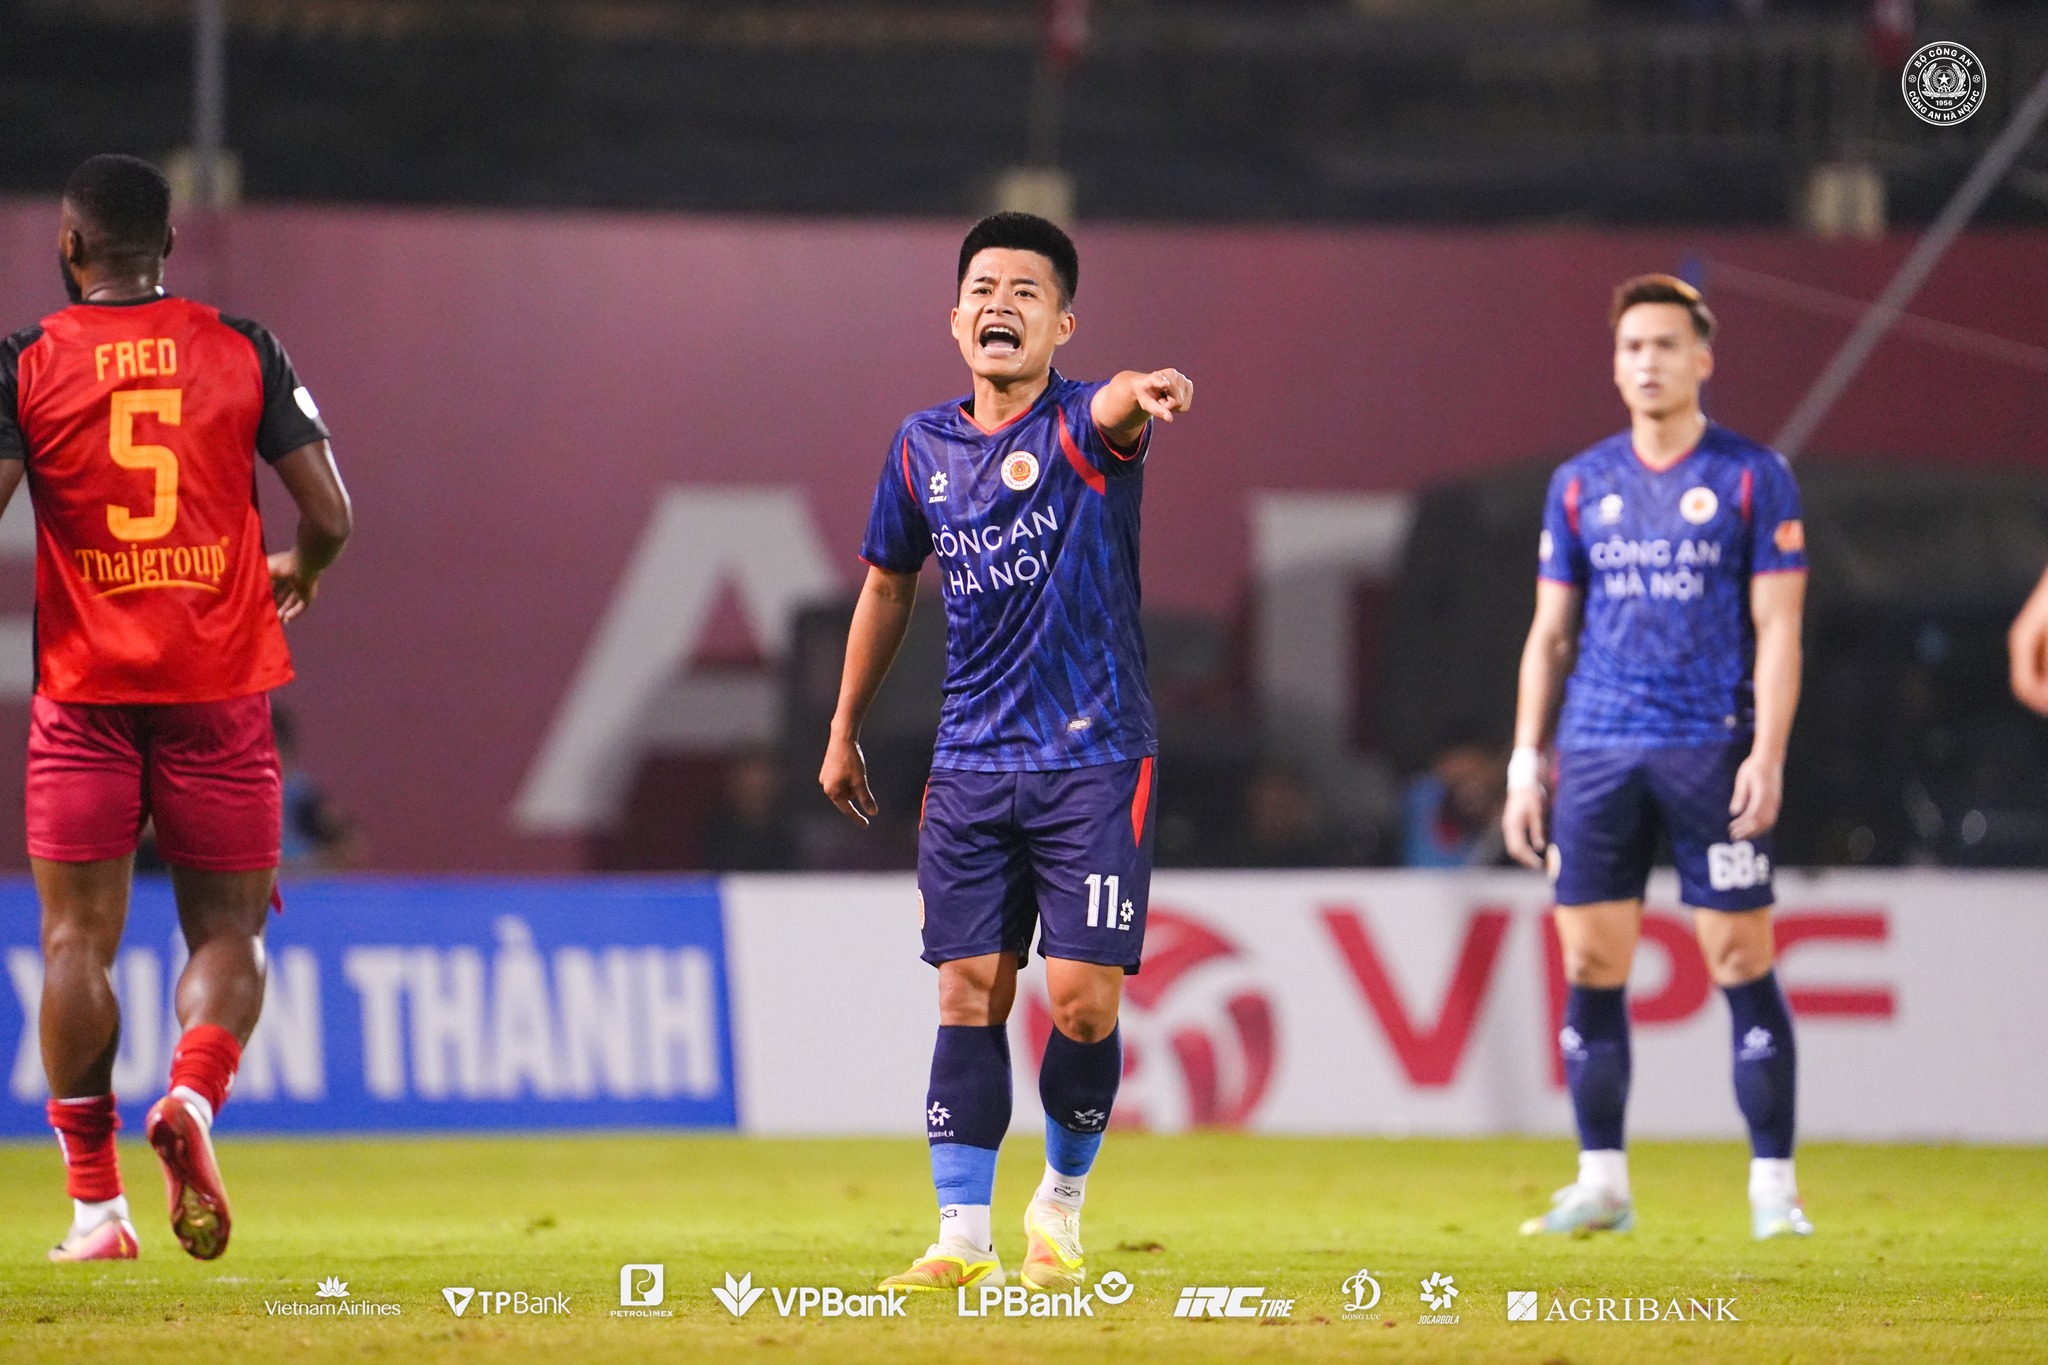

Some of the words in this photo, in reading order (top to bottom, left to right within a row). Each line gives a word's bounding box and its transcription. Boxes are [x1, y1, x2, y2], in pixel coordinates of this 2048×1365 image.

[95, 338, 178, 381] FRED
[106, 388, 183, 541] 5
[931, 524, 1003, 558] CÔNG
[1010, 505, 1059, 545] AN
[949, 563, 984, 596] HÀ
[988, 549, 1051, 591] NỘI
[1707, 840, 1755, 891] 68
[1084, 873, 1119, 929] 11
[344, 913, 722, 1100] THÀNH
